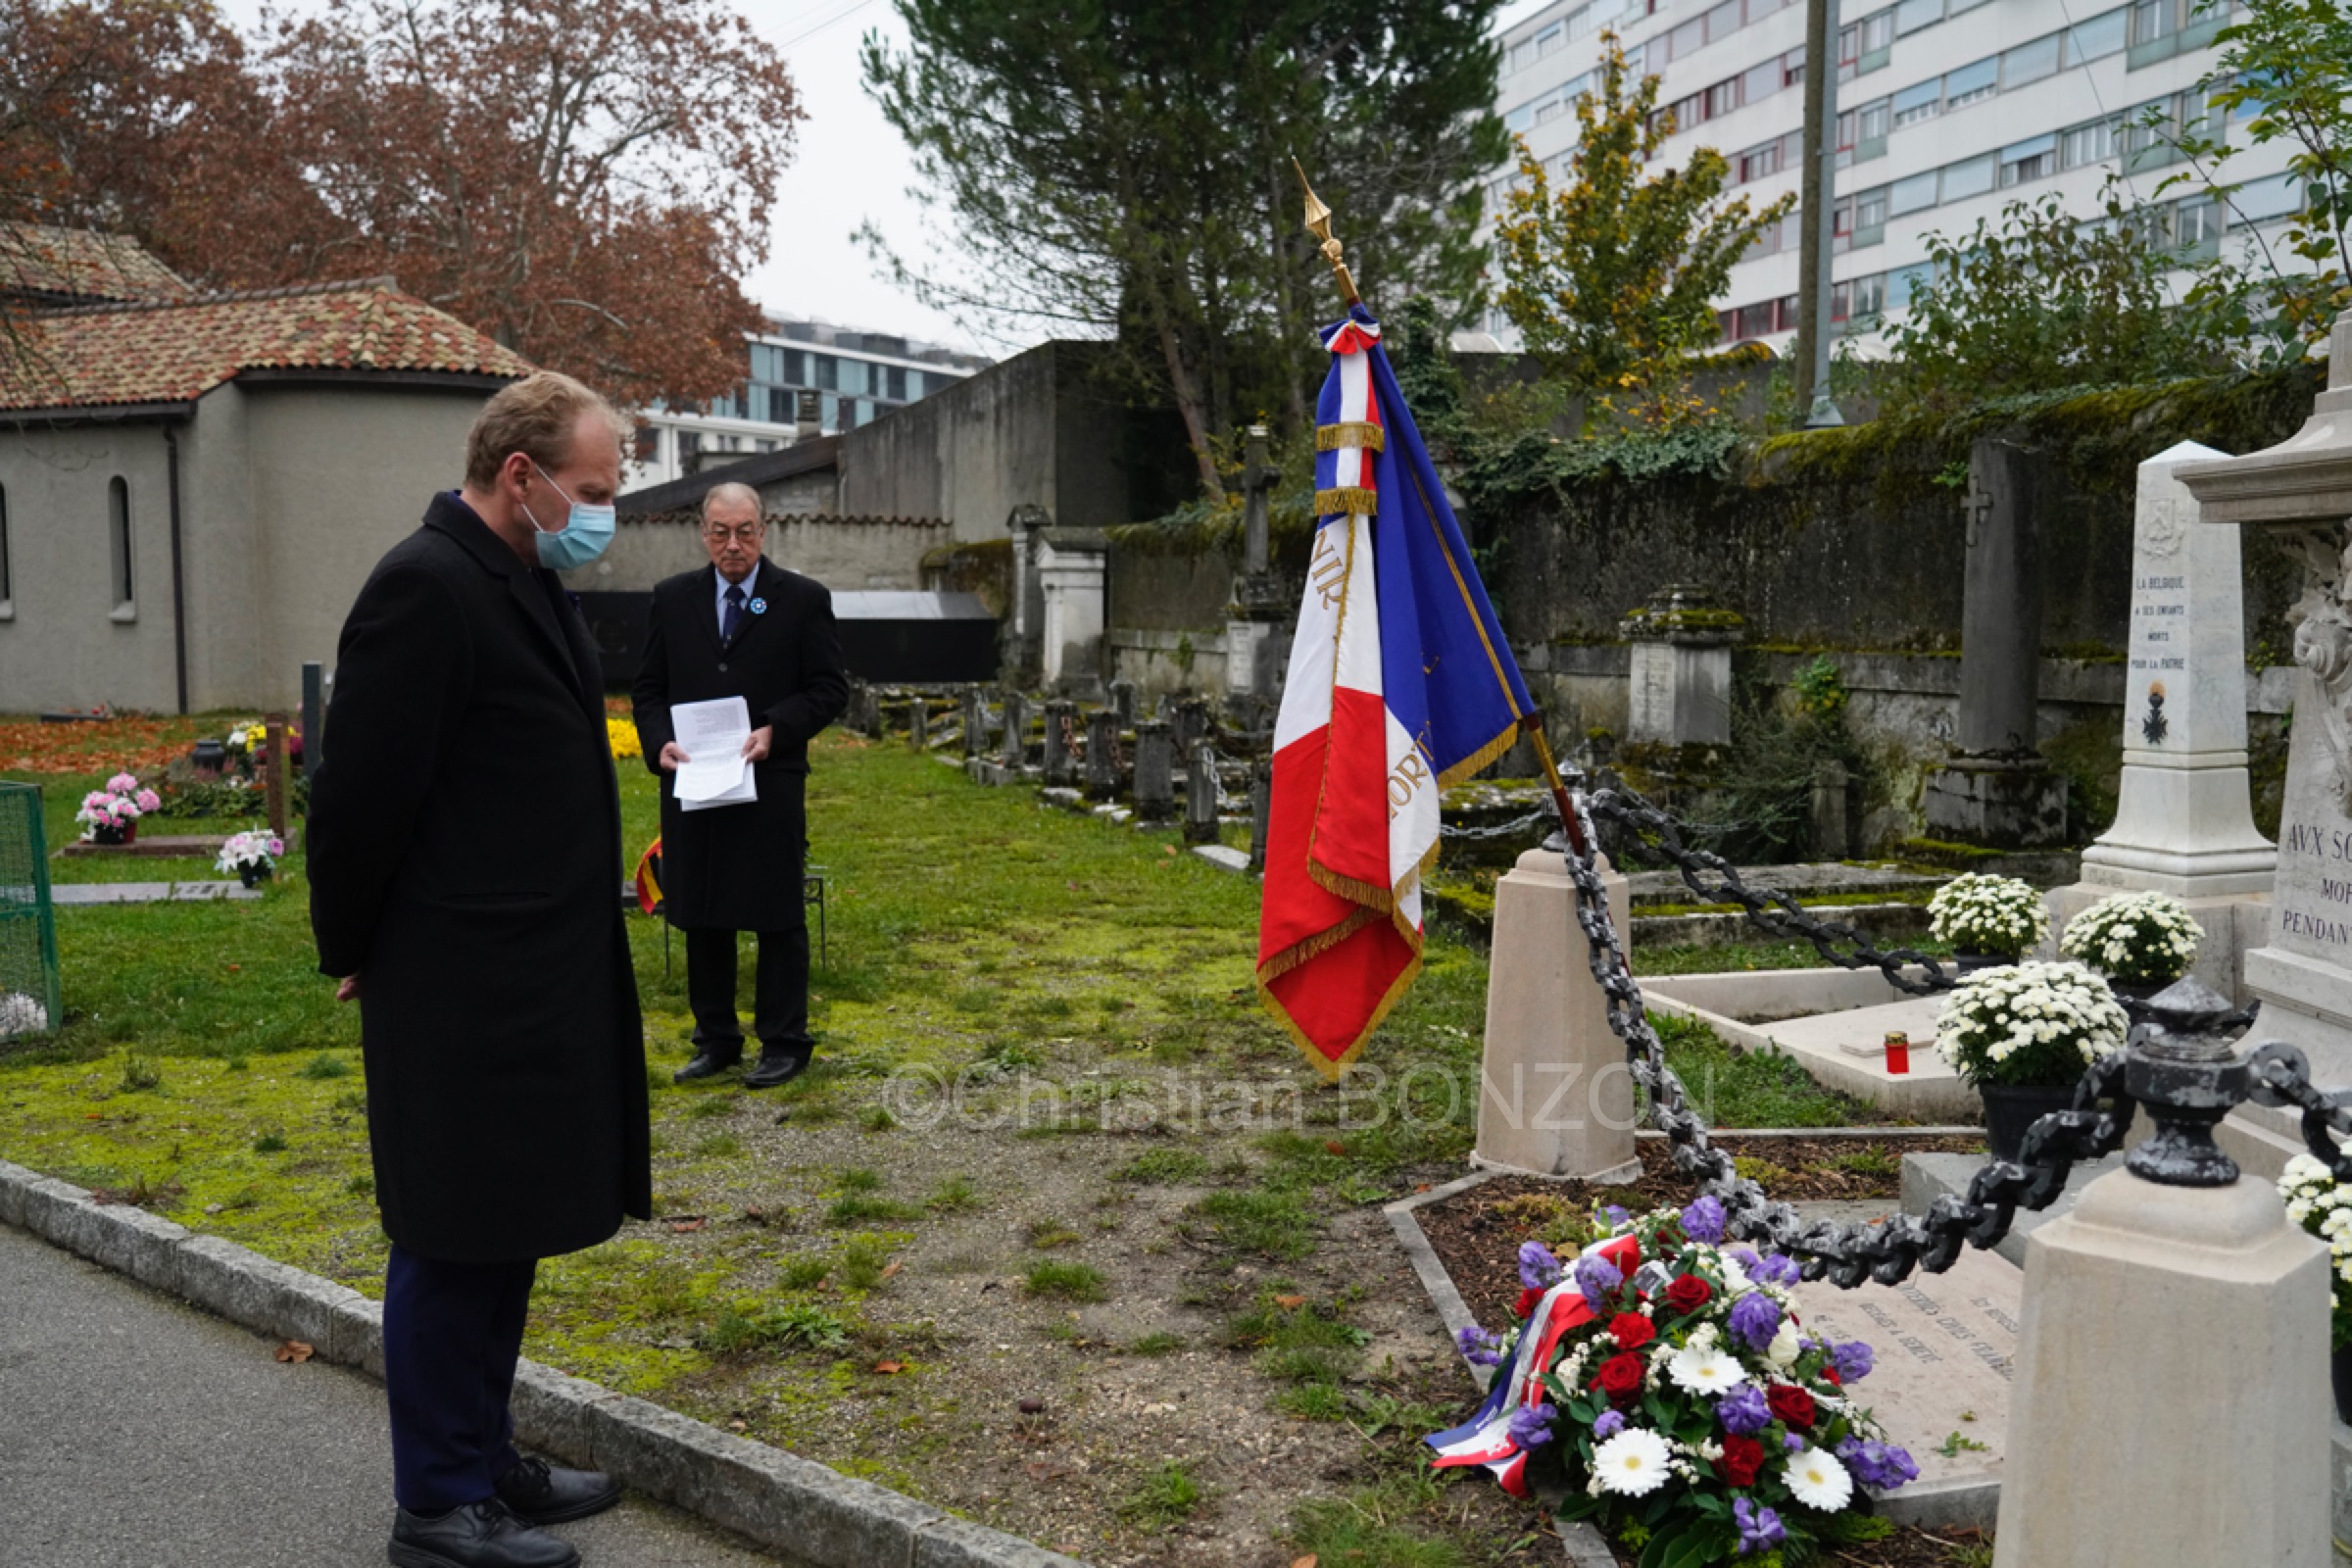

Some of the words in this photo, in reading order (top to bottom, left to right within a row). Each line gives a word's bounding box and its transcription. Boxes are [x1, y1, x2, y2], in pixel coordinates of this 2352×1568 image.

[2135, 577, 2146, 590] LA
[2149, 576, 2184, 590] BELGIQUE
[2148, 631, 2169, 641] MORTS
[2131, 659, 2147, 669] POUR
[2149, 660, 2159, 669] LA
[2161, 659, 2184, 669] PATRIE
[2282, 909, 2352, 945] PENDAN
